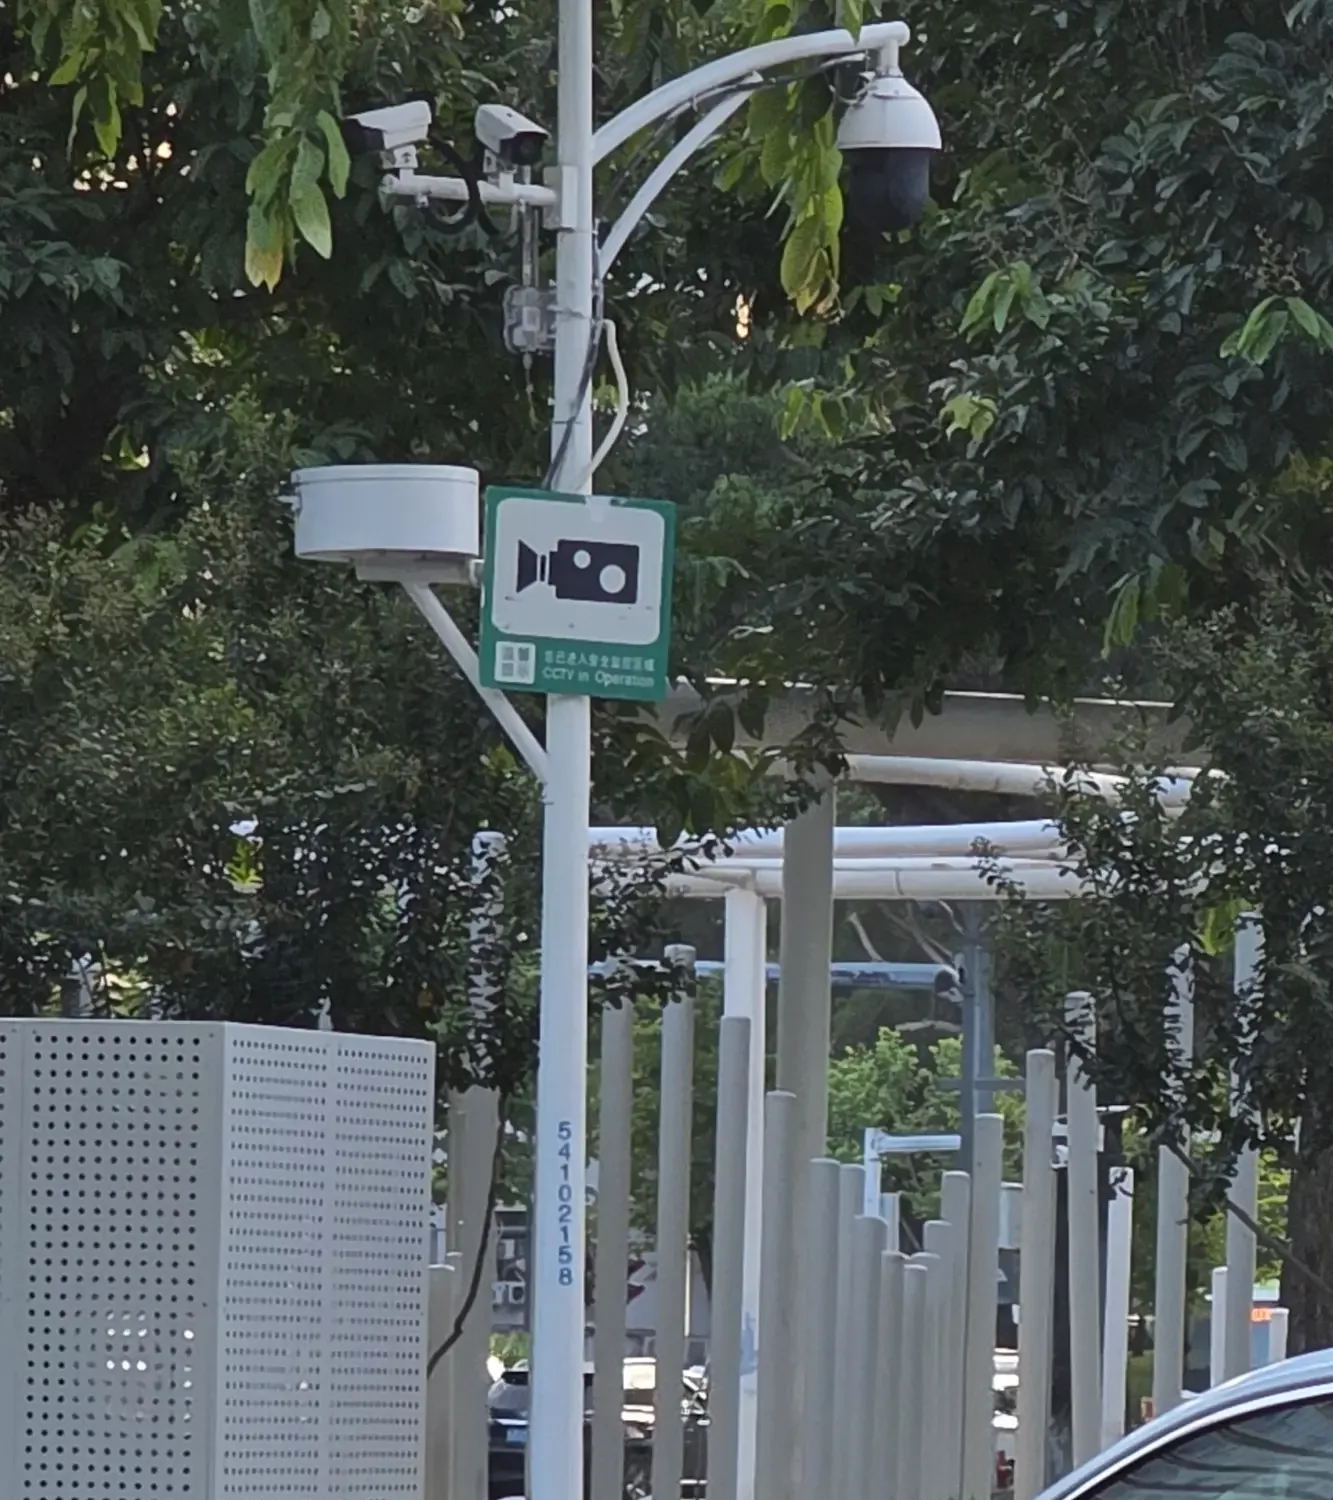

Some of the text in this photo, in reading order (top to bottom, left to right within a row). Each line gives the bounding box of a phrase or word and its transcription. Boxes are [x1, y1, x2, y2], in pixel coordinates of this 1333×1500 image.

[542, 666, 654, 687] CCTV in Operation
[557, 1121, 573, 1286] 54102158
